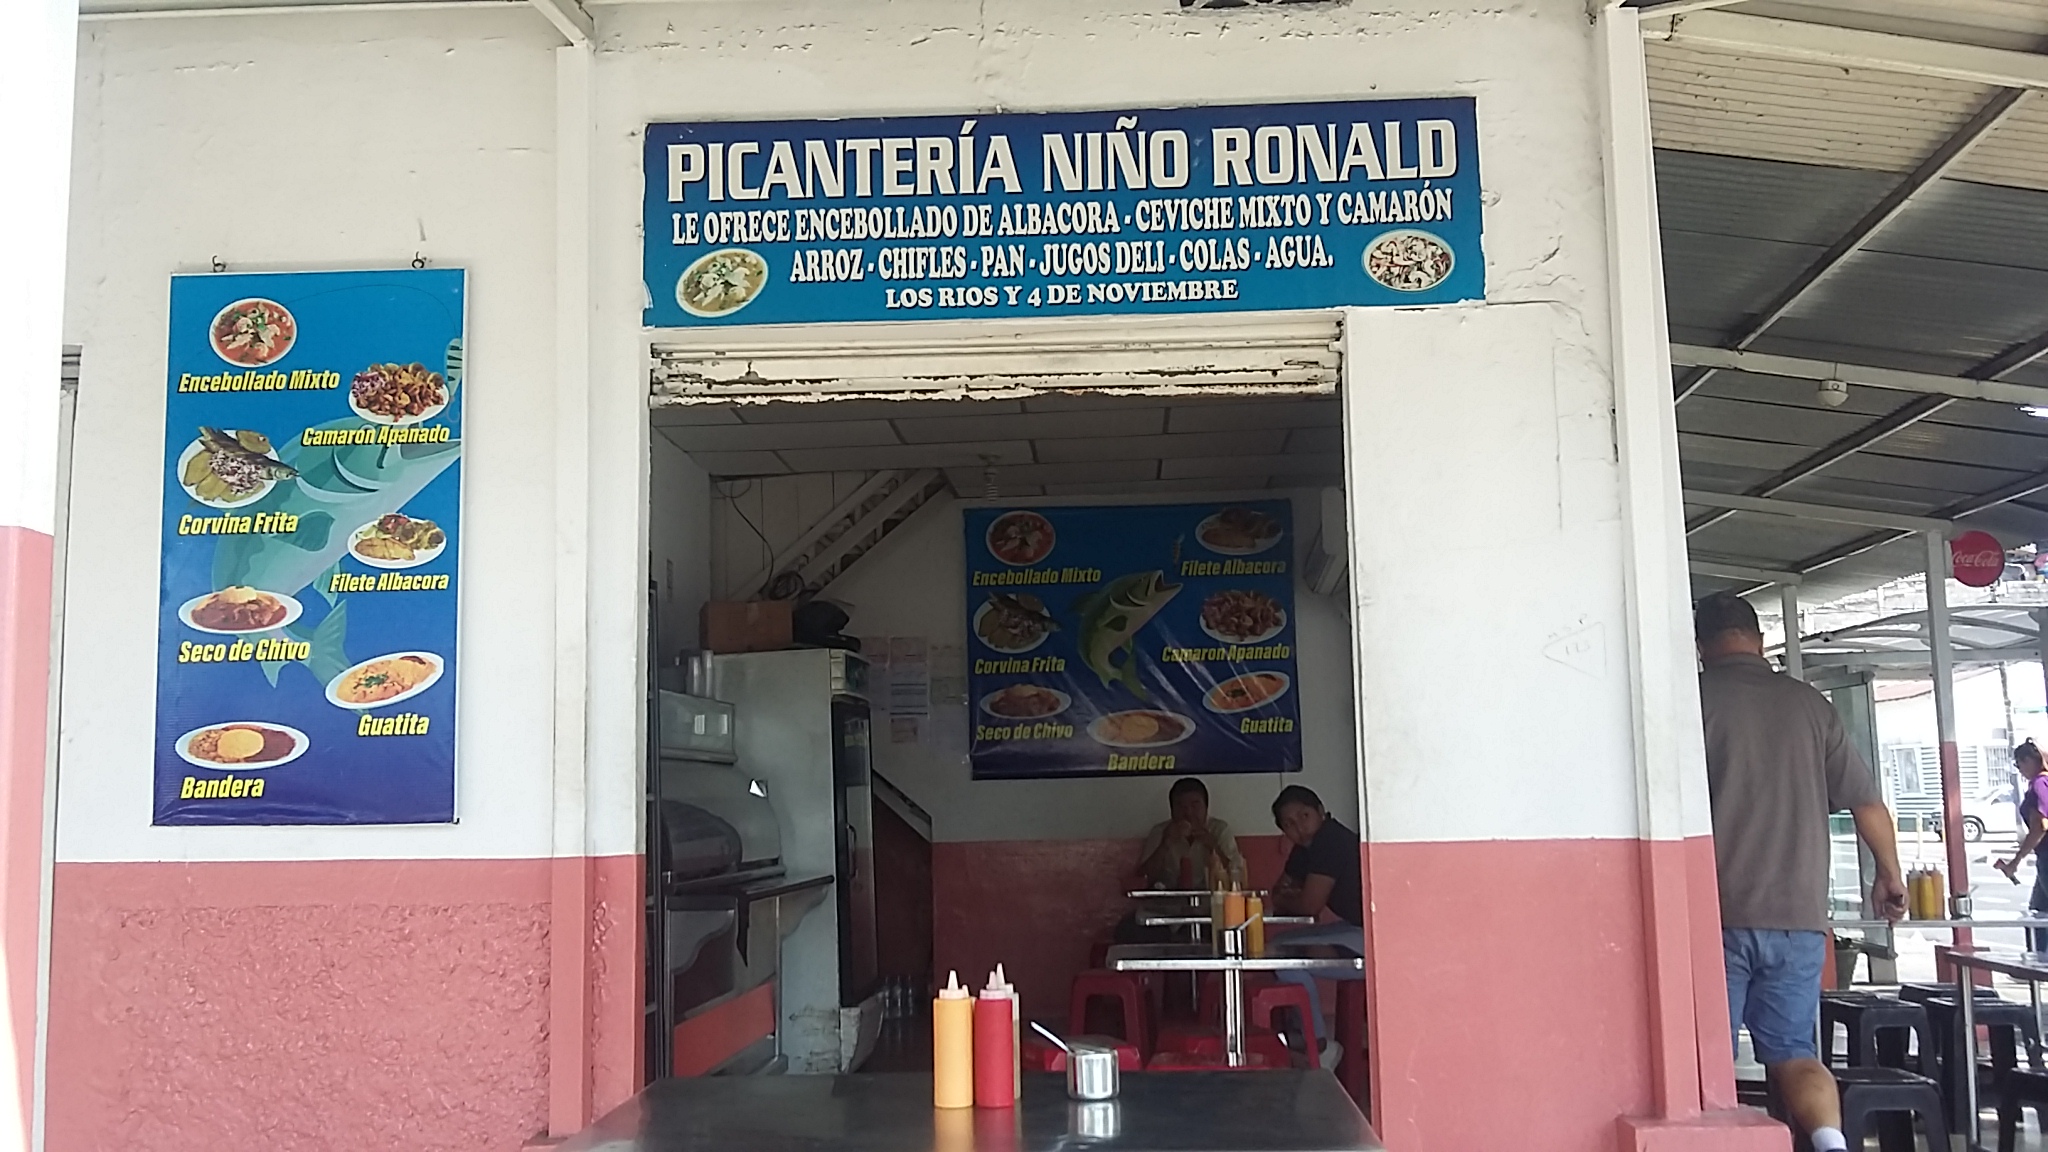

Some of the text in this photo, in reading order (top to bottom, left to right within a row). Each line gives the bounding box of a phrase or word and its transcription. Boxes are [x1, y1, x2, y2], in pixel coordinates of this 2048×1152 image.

[667, 116, 1457, 202] PICANTERÍA NIÑO RONALD
[672, 212, 699, 245] LE
[703, 208, 791, 244] OFRECE
[794, 205, 958, 241] ENCEBOLLADO
[962, 204, 992, 237] DE
[997, 200, 1120, 236] ALBACORA
[1135, 195, 1235, 232] CEVICHE
[1238, 193, 1312, 229] MIXTO
[1317, 191, 1334, 224] Y
[1337, 180, 1453, 224] CAMARÓN
[789, 249, 864, 282] ARROZ
[878, 246, 967, 280] CHIFLES
[980, 244, 1026, 277] PAN
[1039, 240, 1111, 276] JUGOS
[1115, 239, 1165, 274] DELI
[1179, 236, 1251, 272] COLAS
[1265, 234, 1335, 269] AGUA.
[885, 280, 1239, 310] LOS RIOS Y 4 DE NOVIEMBRE
[178, 370, 341, 393] Encebollado Mixto
[377, 424, 451, 448] Apanado
[178, 511, 299, 536] Corvina Frita
[973, 565, 1102, 586] Encebollado Mixto
[1181, 558, 1287, 577] Filete Albacora
[329, 571, 450, 595] Filete Albacora
[178, 638, 311, 663] Seco de Chivo
[1161, 642, 1290, 663] Camaron Apanado
[974, 655, 1066, 675] Corvina Frita
[357, 712, 431, 737] Guatita
[976, 721, 1073, 741] Seco de Chivo
[1240, 716, 1294, 734] Guatita
[1107, 752, 1176, 772] Bandera
[180, 774, 265, 800] Bandera
